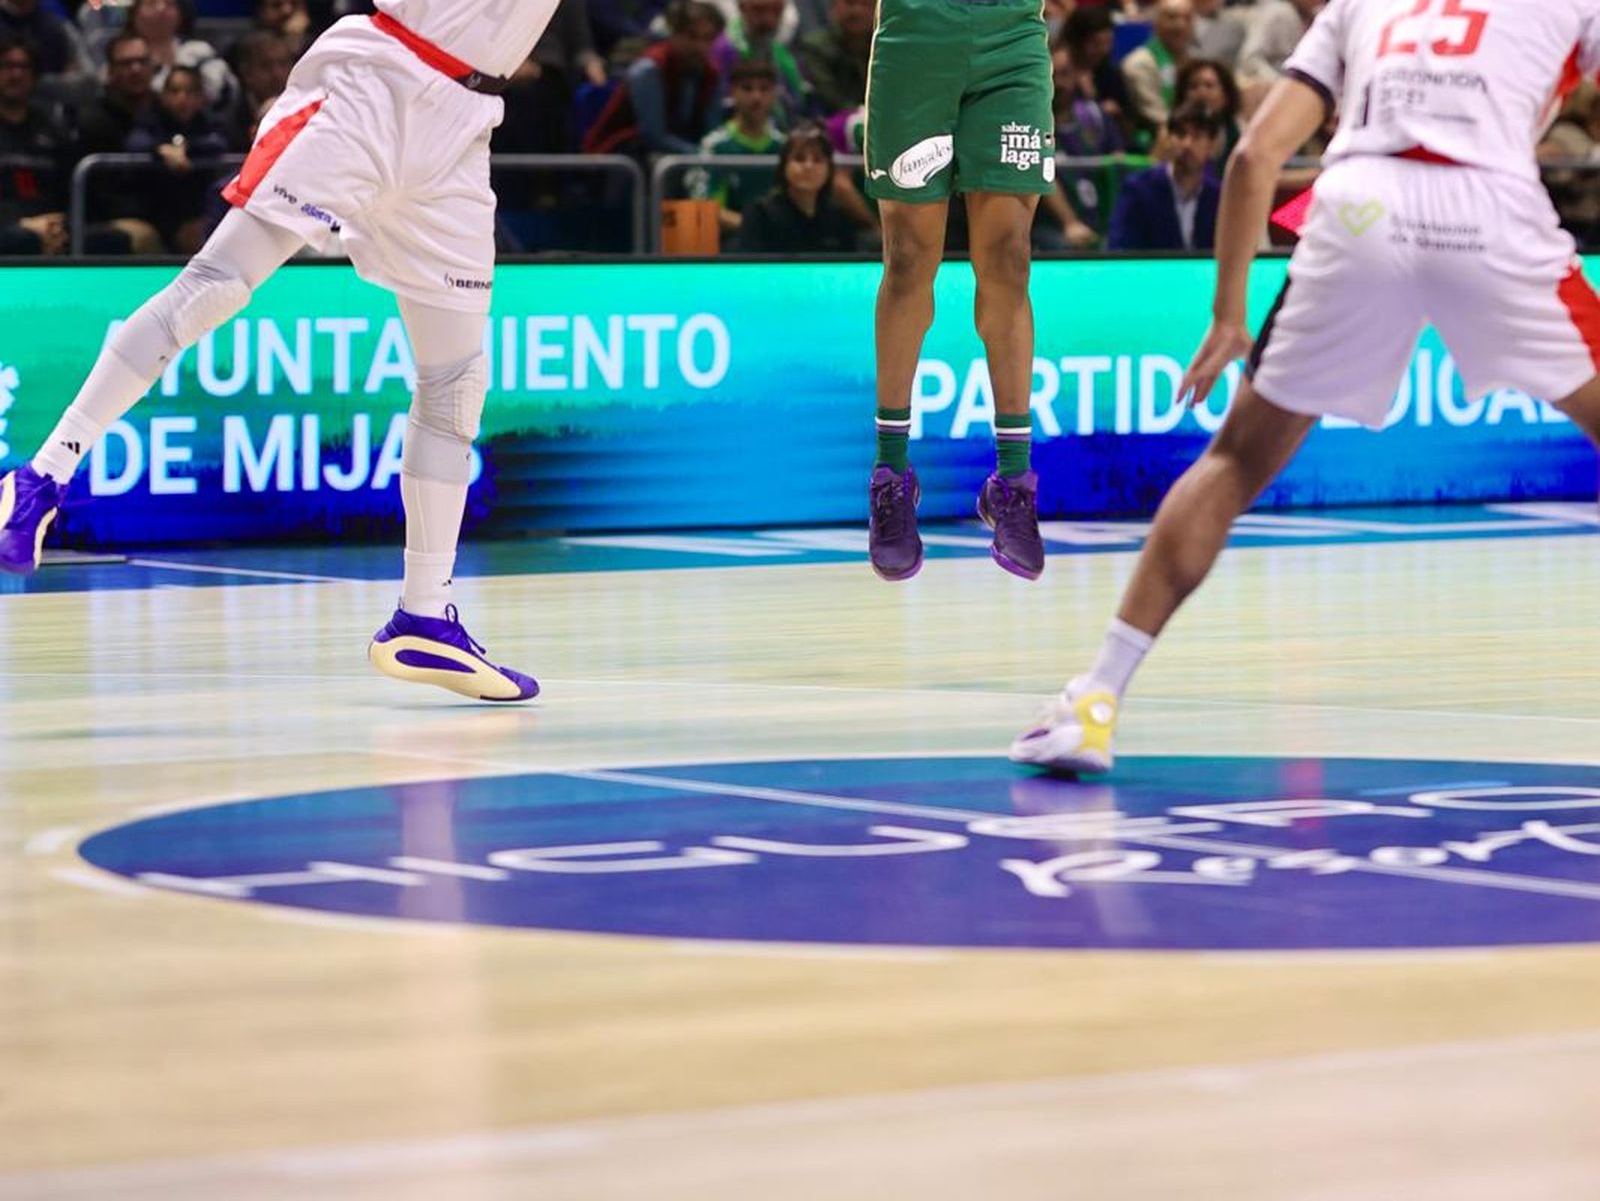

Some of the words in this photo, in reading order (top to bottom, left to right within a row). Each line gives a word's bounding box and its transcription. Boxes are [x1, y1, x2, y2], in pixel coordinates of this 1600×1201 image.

[1001, 121, 1032, 133] sabor
[1001, 145, 1041, 171] laga
[1008, 128, 1041, 149] má
[106, 313, 731, 396] UNTAIENTO
[908, 354, 1242, 440] PARTIDO
[90, 415, 198, 497] DE
[223, 412, 484, 493] MIJA
